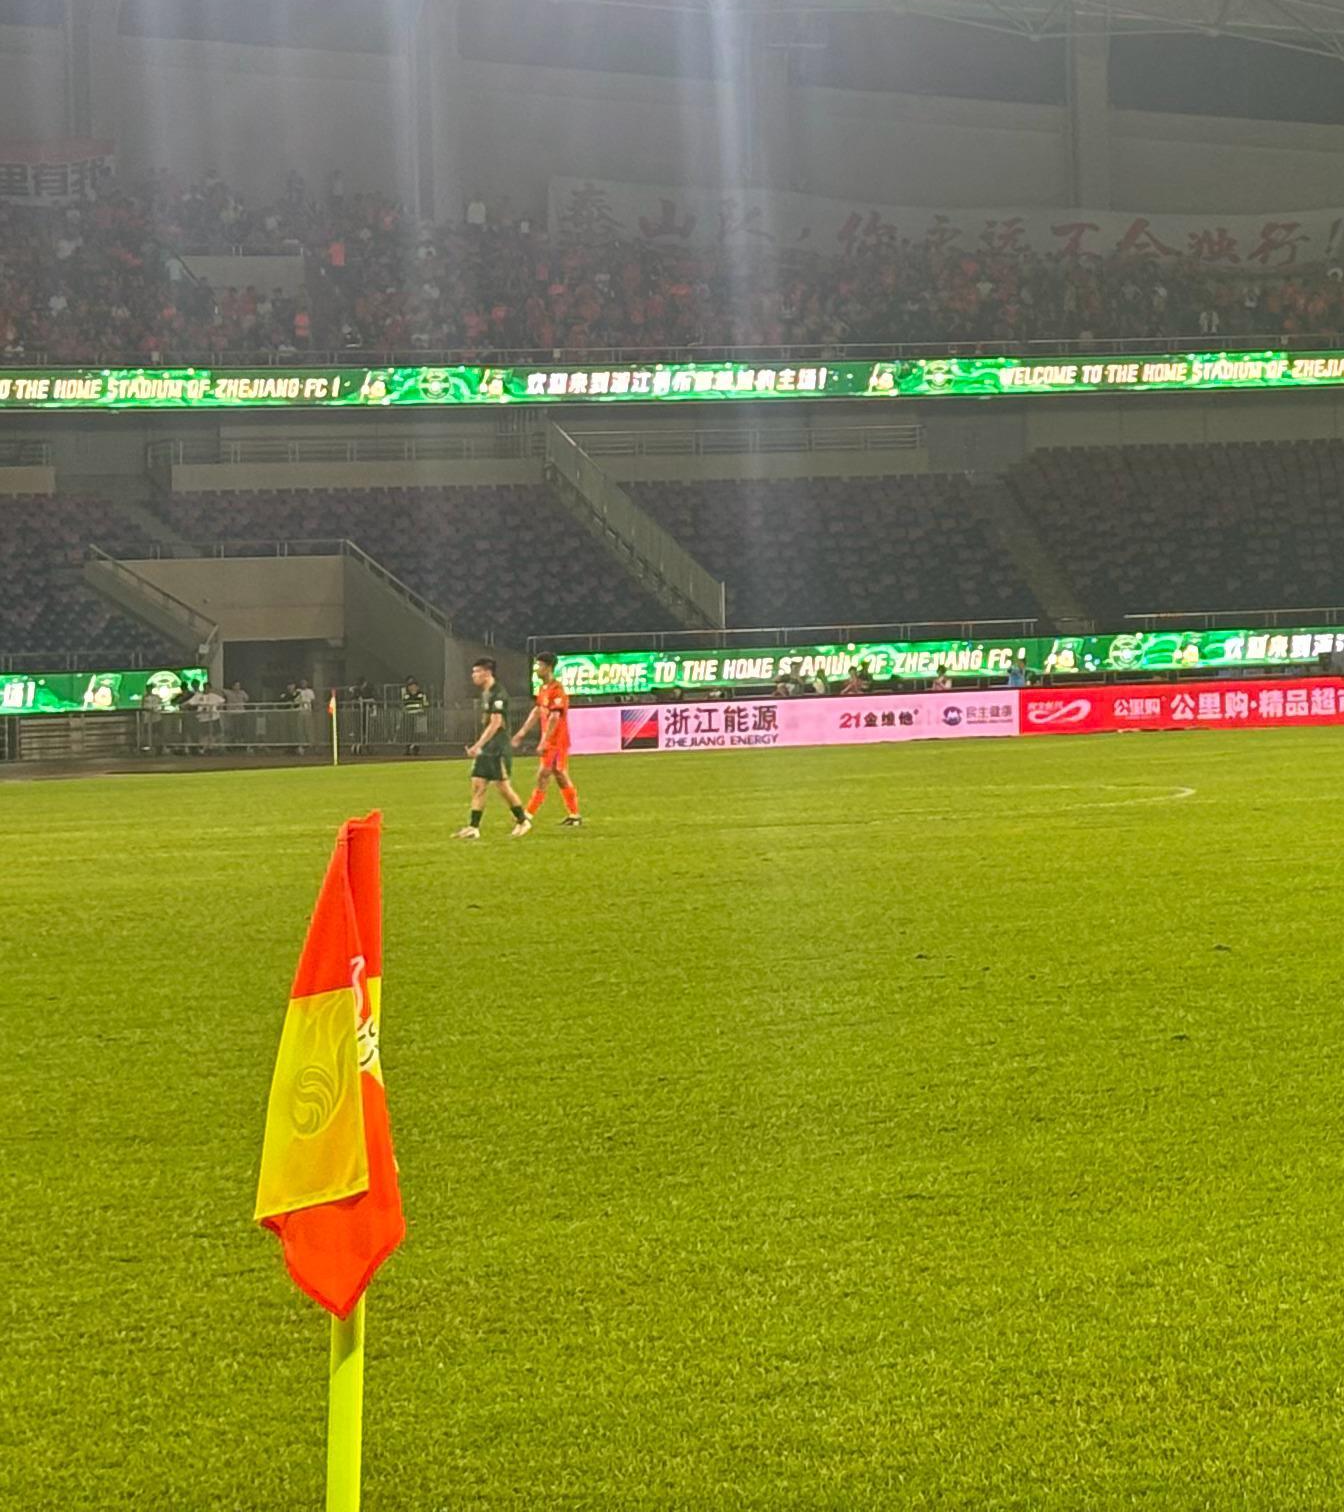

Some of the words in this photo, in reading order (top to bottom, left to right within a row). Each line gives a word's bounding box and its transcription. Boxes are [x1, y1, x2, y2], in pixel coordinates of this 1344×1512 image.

[1000, 365, 1077, 385] WELCOME
[1081, 364, 1104, 384] TO
[1106, 363, 1139, 383] THE
[1142, 362, 1188, 382] HOME
[1191, 359, 1263, 381] STADIUM
[15, 379, 48, 400] THE
[54, 378, 102, 399] HOME
[107, 376, 184, 399] STADIUM
[214, 377, 299, 398] ZHEJIANG
[560, 662, 648, 687] WELCOME
[654, 660, 677, 683] TO
[682, 659, 719, 681] THE
[723, 656, 775, 680] HOME
[893, 648, 984, 674] ZHEJIANG
[664, 704, 779, 736] 浙江能源
[664, 734, 726, 749] ZHEJIANG
[730, 733, 779, 746] ENERGY
